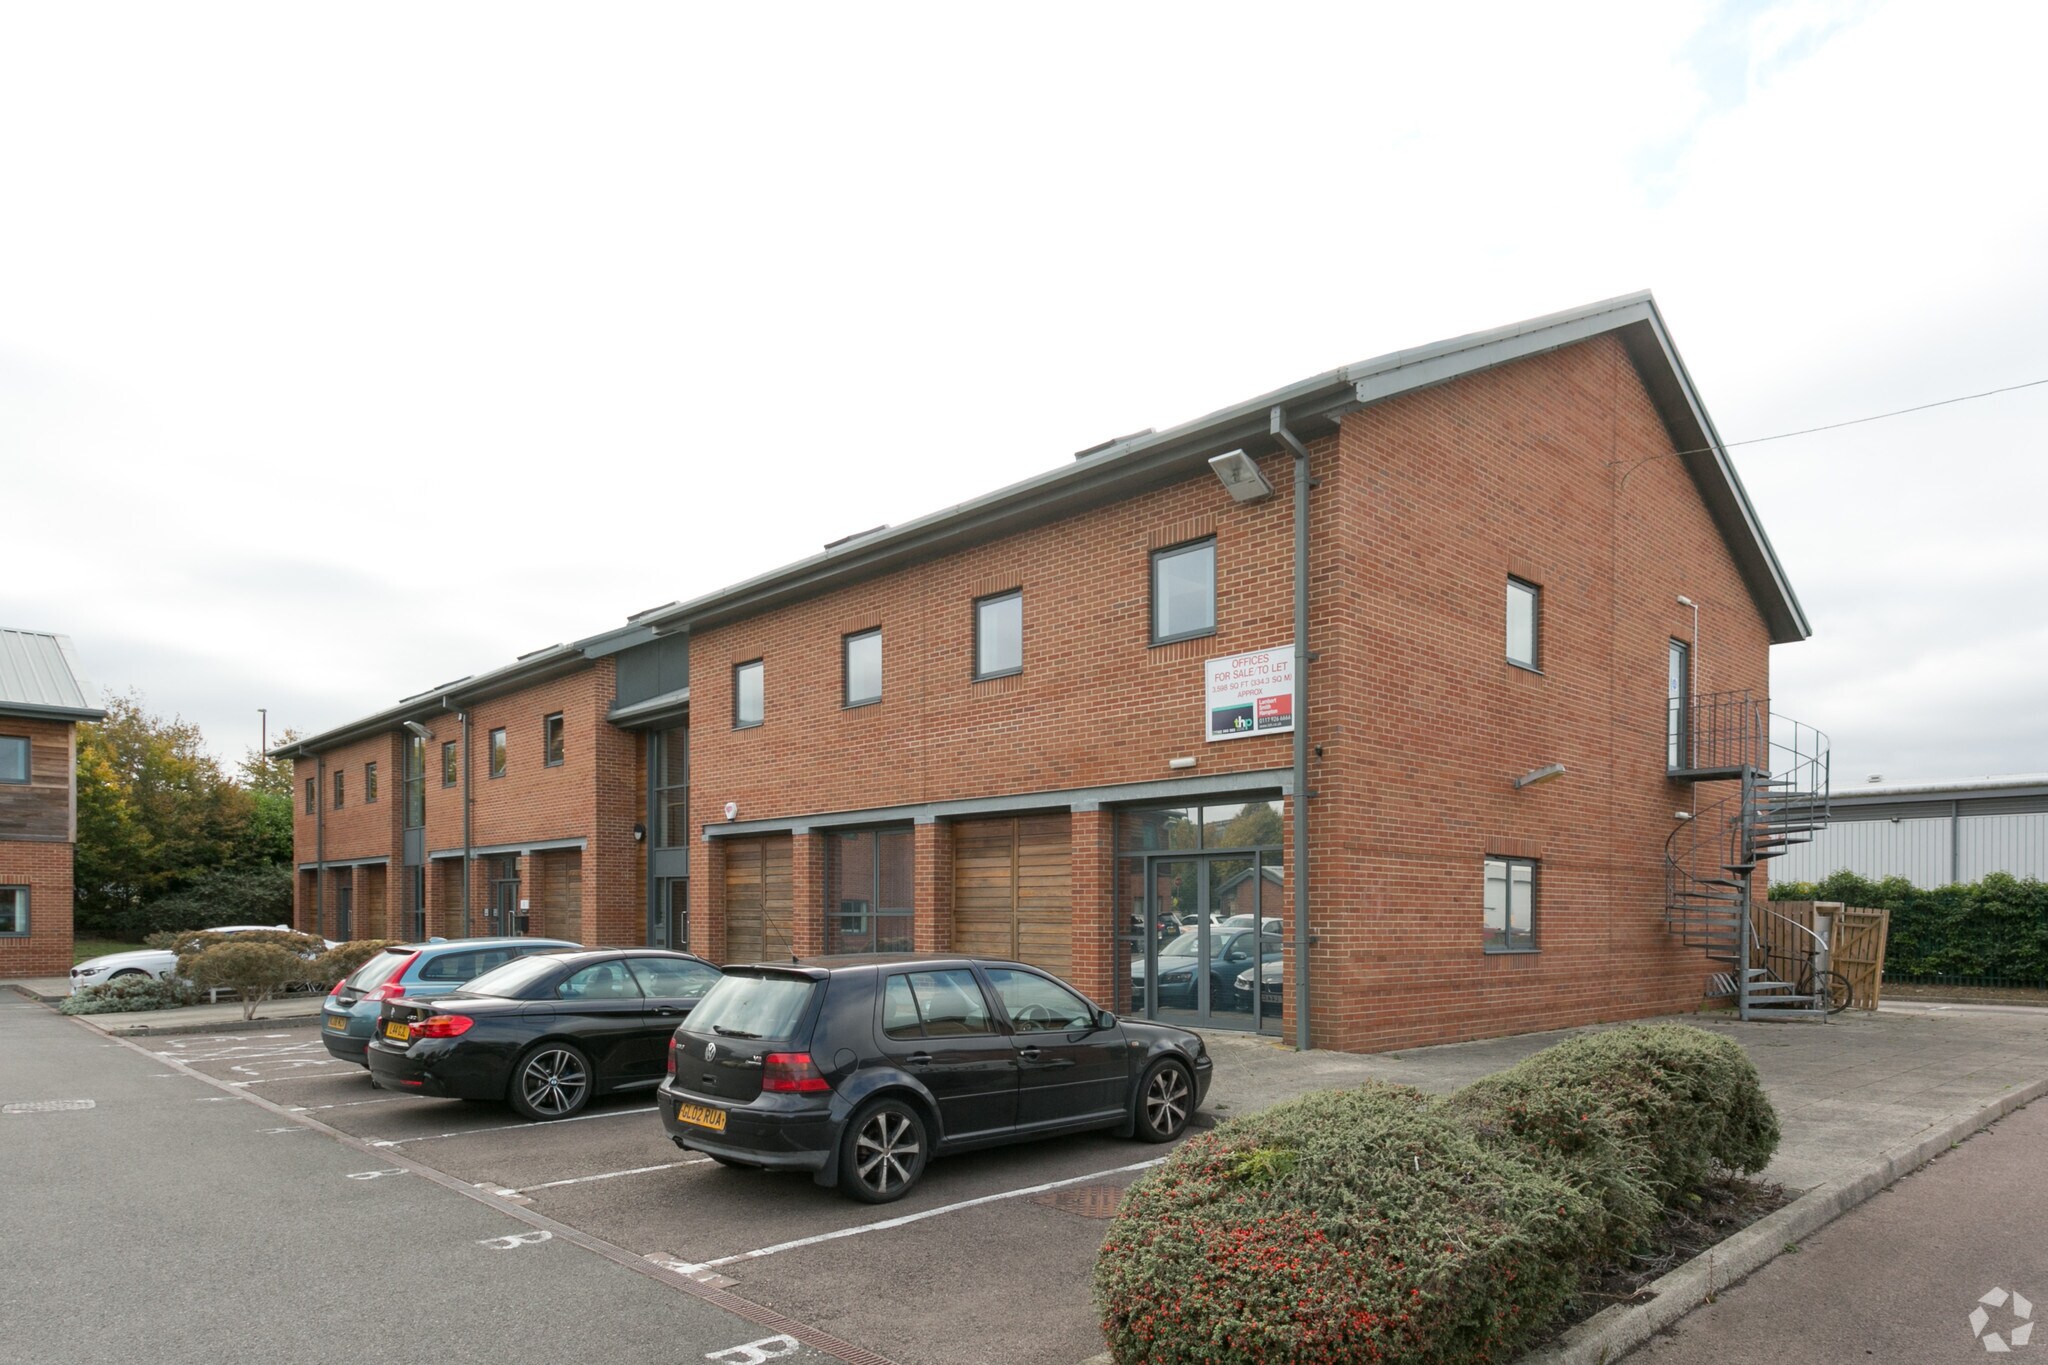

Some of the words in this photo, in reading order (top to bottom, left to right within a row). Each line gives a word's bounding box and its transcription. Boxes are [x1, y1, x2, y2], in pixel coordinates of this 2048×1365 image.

[1232, 654, 1269, 668] OFFICES
[1214, 672, 1230, 682] FOR
[1272, 662, 1288, 672] LET
[1272, 675, 1282, 683] SQ
[1237, 688, 1263, 698] APPROX
[1234, 715, 1253, 731] thp
[1259, 716, 1270, 724] 0117
[682, 1103, 702, 1120] GL02
[703, 1109, 722, 1126] RUA
